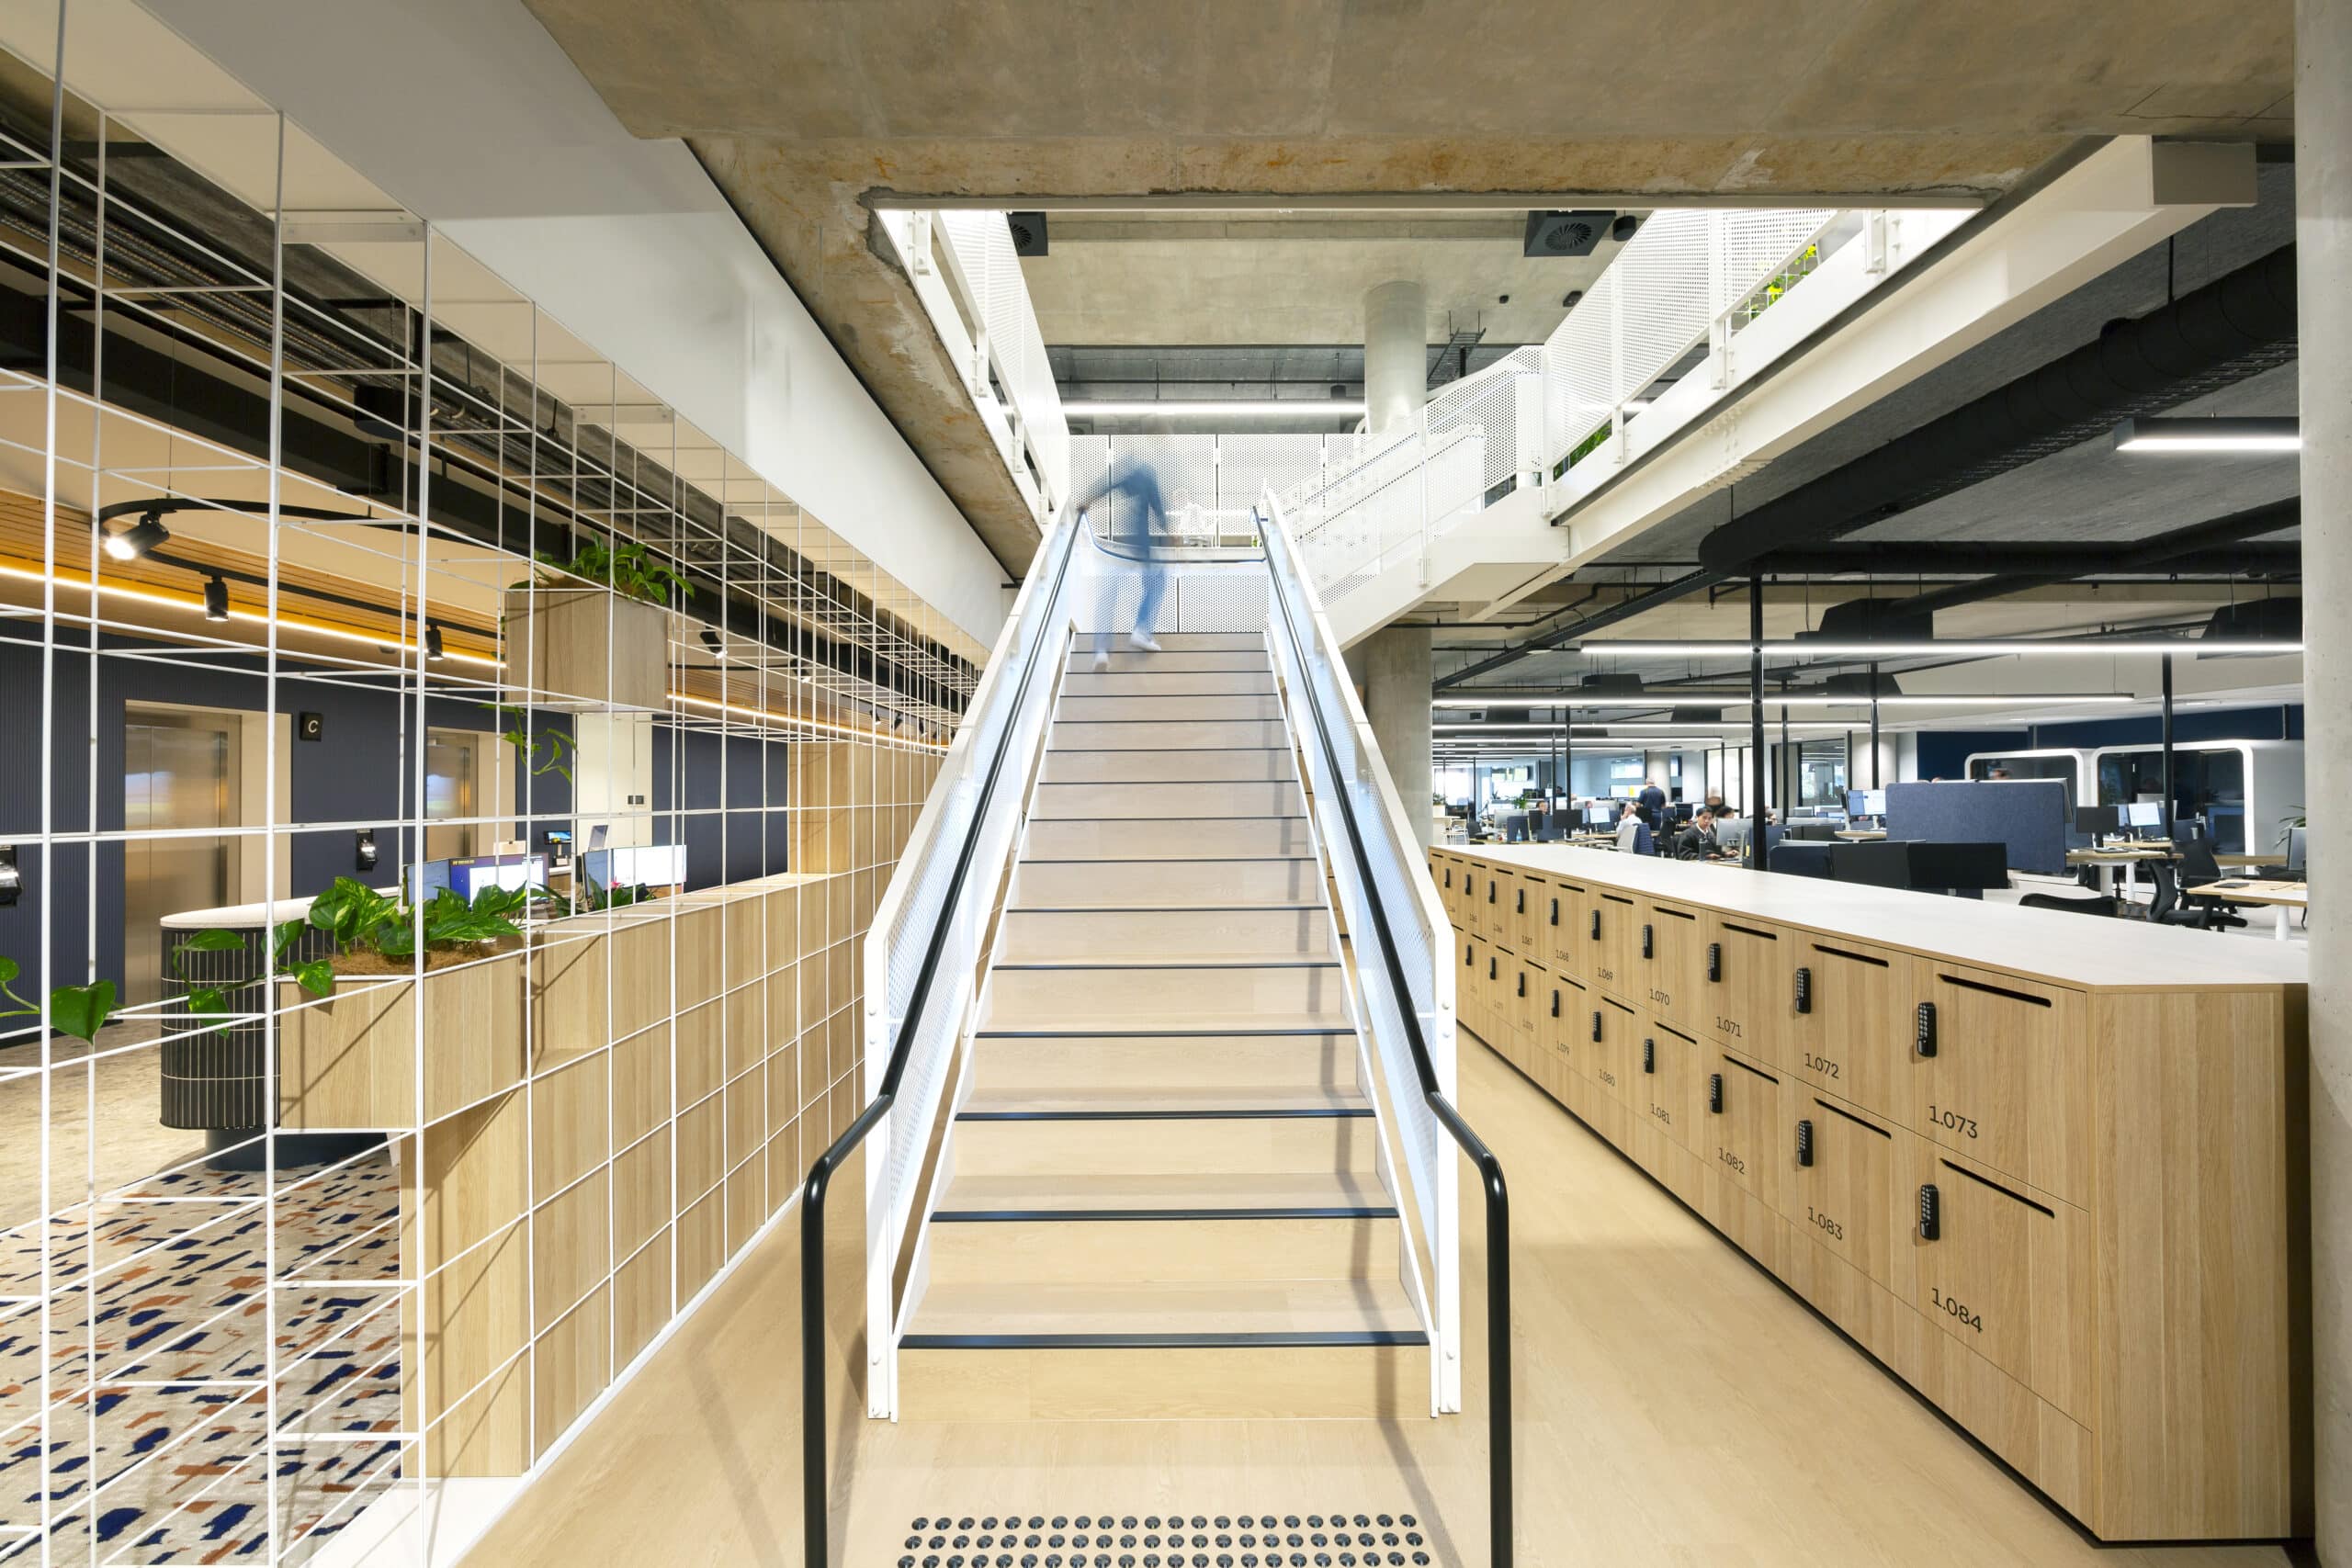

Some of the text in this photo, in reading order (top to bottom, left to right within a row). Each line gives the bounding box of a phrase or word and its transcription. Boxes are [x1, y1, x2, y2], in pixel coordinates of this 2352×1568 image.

[308, 719, 319, 733] C
[1555, 949, 1569, 963] 1.068
[1598, 966, 1613, 981] 1.069
[1649, 988, 1670, 1006] 1.070
[1716, 1016, 1742, 1038] 1.071
[1804, 1053, 1840, 1079] 1.072
[1599, 1068, 1616, 1087] 1.080
[1650, 1103, 1670, 1125] 1.081
[1928, 1105, 1979, 1139] 1.073
[1718, 1147, 1746, 1175] 1.082
[1807, 1206, 1844, 1241] 1.083
[1931, 1287, 1983, 1334] 1.084
